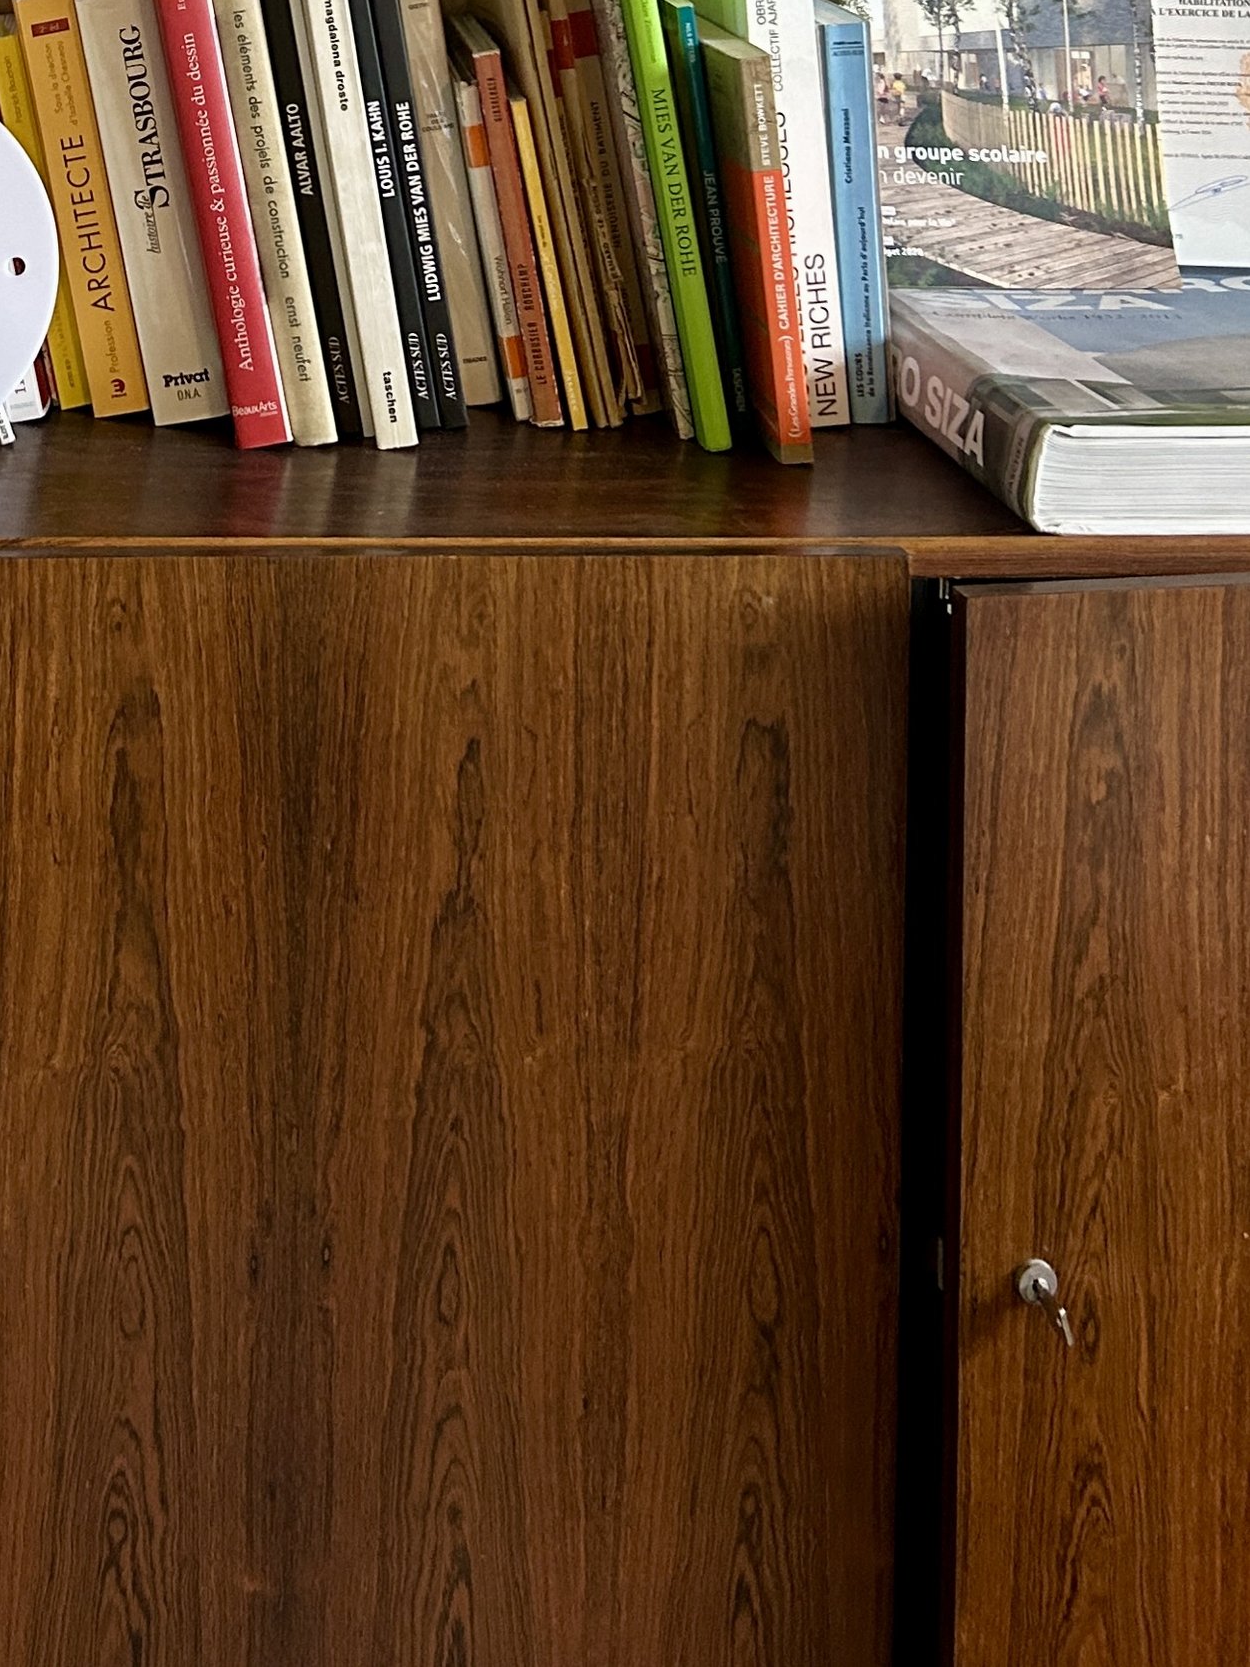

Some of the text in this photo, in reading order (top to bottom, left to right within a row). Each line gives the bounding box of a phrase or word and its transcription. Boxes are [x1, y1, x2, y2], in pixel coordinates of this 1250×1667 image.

[1158, 7, 1221, 18] L'EXERCICE
[1221, 9, 1236, 19] DE
[334, 70, 348, 111] droste
[768, 29, 784, 93] COLLECTIF
[119, 24, 170, 209] STRASBOURG
[233, 9, 290, 279] les éléments des projets de construction
[285, 103, 314, 196] ALVAR AALTO
[367, 100, 395, 198] LOUIS I. KAHN
[752, 83, 771, 166] STEVE BOWKETT
[893, 144, 1049, 164] groupe scolaire
[181, 32, 254, 372] Anthologie curieuse & passionnée du dessin
[396, 101, 441, 302] LUDWIG MIES VAN DER ROHE
[600, 160, 610, 179] DU
[650, 89, 697, 278] MIES VAN DER ROHE
[703, 171, 718, 206] JEAN
[893, 167, 965, 184] devenir
[60, 134, 115, 312] ARCHITECTE
[140, 210, 162, 254] histoire
[762, 175, 791, 331] CAHIER D'ARCHITECTURE
[103, 319, 119, 373] Profession
[285, 296, 311, 383] ernst neufert
[517, 263, 547, 385] LE CORBUSIER RONCHAMP
[804, 253, 838, 416] NEW RICHES
[162, 368, 211, 388] Privat
[328, 336, 350, 404] ACTES SUD
[383, 371, 398, 423] taschen
[407, 332, 429, 400] ACTES SUD
[435, 333, 458, 401] ACTES SUD
[924, 374, 986, 468] SIZA
